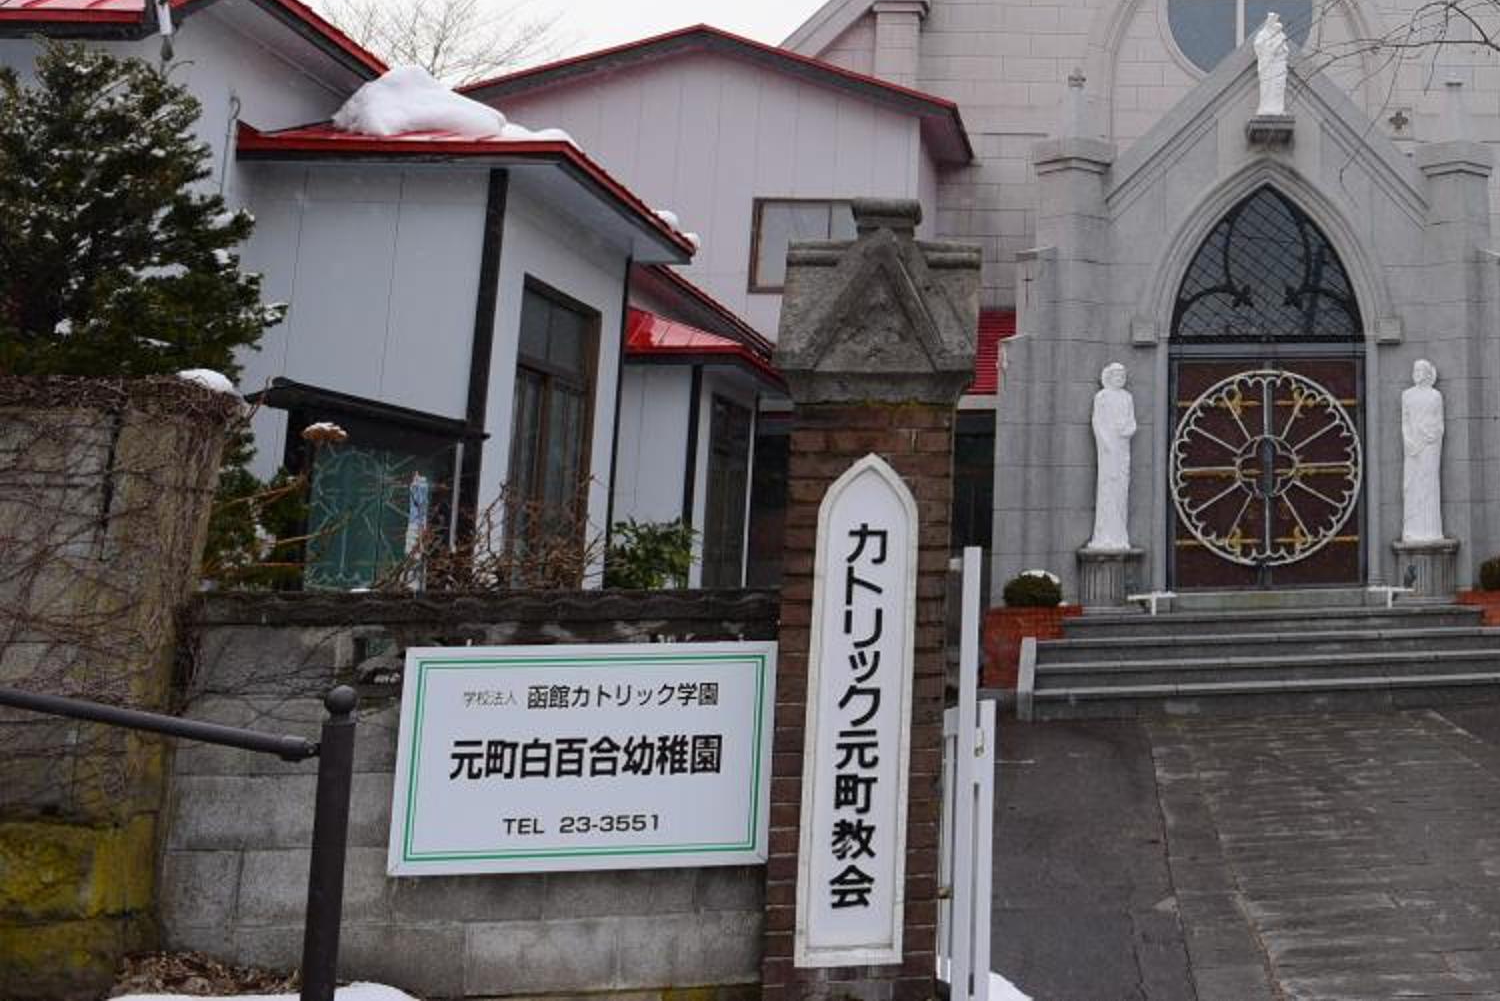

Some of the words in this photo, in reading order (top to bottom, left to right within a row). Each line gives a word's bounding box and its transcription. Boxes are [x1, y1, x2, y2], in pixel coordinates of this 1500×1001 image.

[527, 682, 719, 710] 函館カトリック学園
[829, 522, 888, 909] カトリック元町教会
[449, 734, 722, 780] 元町白百合幼稚園
[502, 818, 545, 835] TEL
[559, 814, 659, 834] 23-3551
